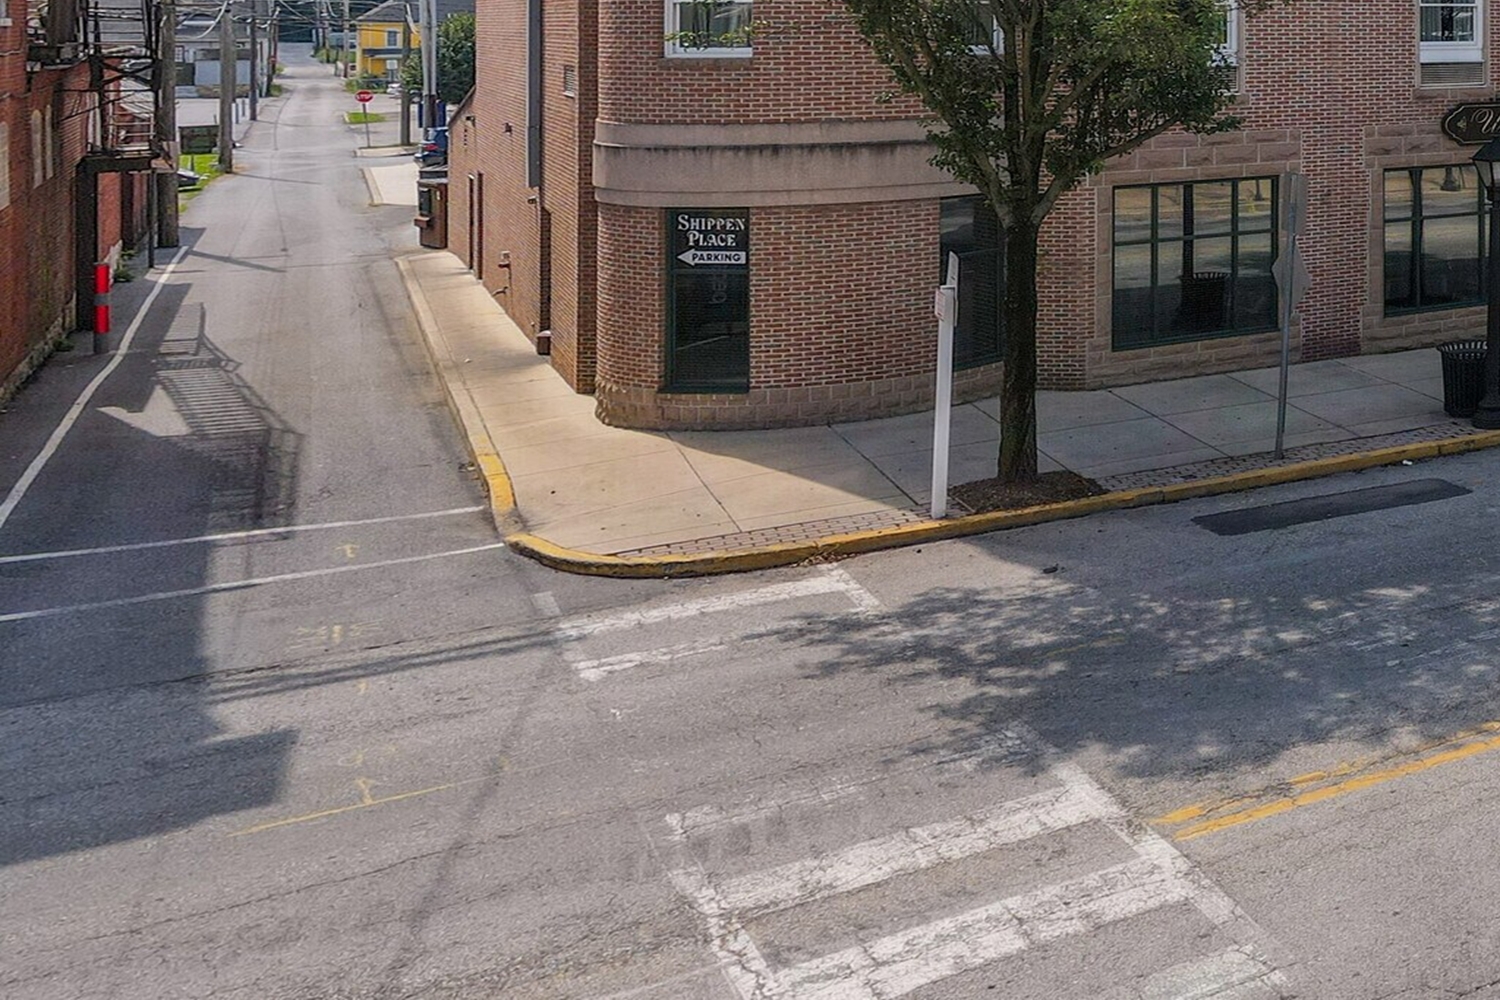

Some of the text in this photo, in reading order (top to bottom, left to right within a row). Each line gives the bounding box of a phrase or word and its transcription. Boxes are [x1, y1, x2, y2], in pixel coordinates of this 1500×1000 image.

[677, 214, 746, 231] SHIPPEN
[687, 231, 736, 246] PLACE
[692, 252, 742, 263] PARKING
